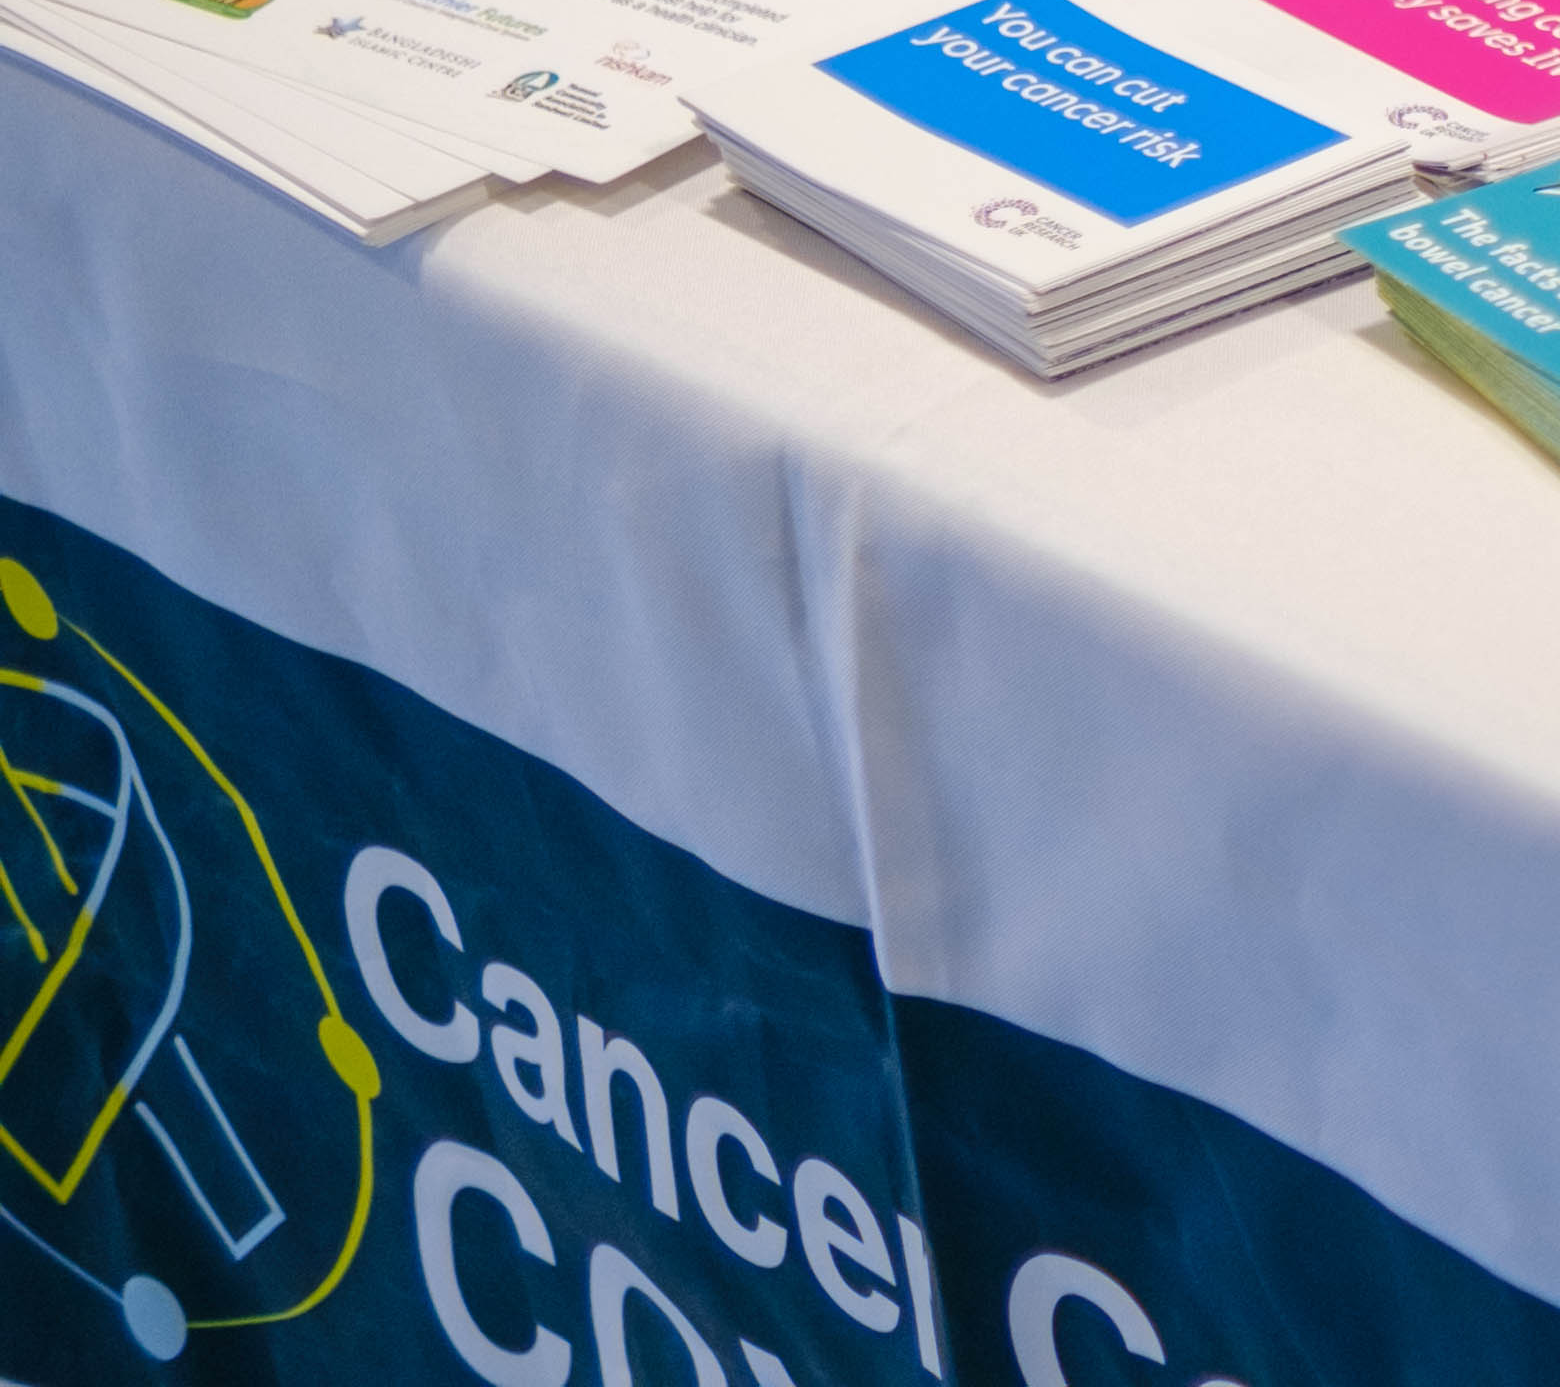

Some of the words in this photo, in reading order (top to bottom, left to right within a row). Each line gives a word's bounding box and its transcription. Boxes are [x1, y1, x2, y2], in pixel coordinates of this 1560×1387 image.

[982, 1, 1059, 52] You
[1045, 46, 1123, 86] can
[1113, 79, 1187, 113] cut
[1427, 5, 1536, 57] saves
[909, 25, 1016, 76] your
[1001, 73, 1137, 135] cancer
[1119, 128, 1201, 169] risk
[1388, 222, 1490, 281] bowel
[1440, 207, 1500, 247] The
